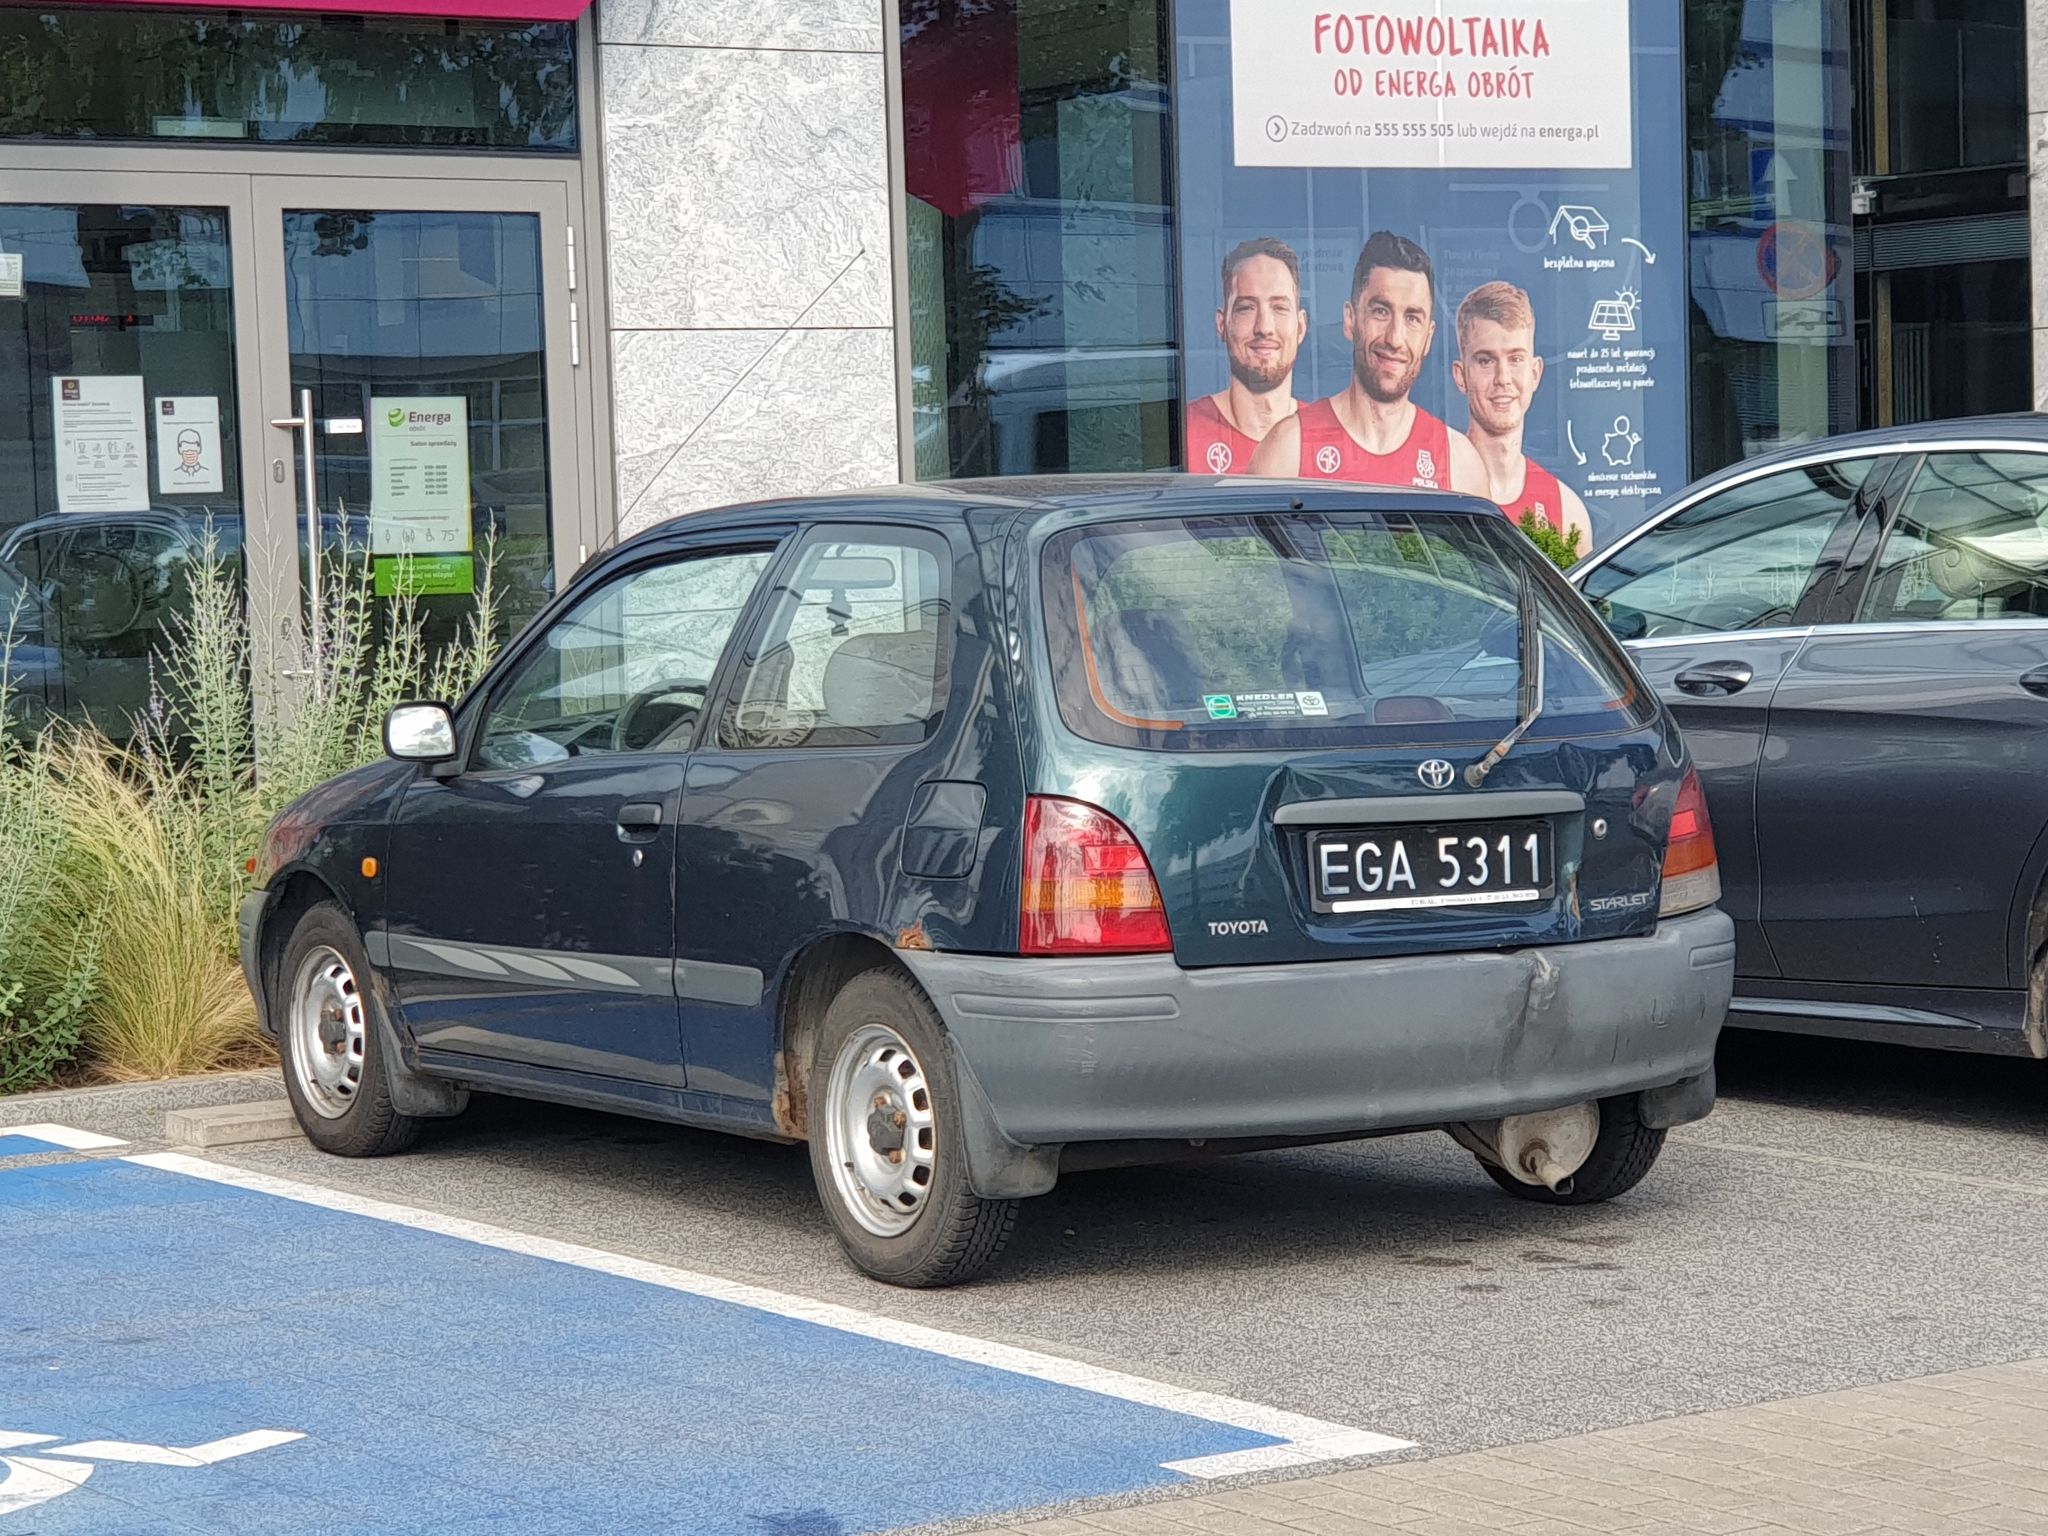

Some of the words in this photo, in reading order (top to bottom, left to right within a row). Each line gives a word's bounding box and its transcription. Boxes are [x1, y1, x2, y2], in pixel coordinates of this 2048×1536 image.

[1314, 13, 1550, 58] FOTOWOLTAIKA
[1334, 68, 1362, 96] OD
[1375, 69, 1456, 98] ENERGA
[1468, 65, 1534, 99] OBRÓT
[1291, 121, 1351, 136] Zadzwoń
[1355, 125, 1371, 136] na
[1375, 123, 1399, 137] 555
[1402, 123, 1427, 137] 555
[1430, 124, 1454, 137] 505
[1457, 123, 1477, 138] lub
[1480, 123, 1517, 141] wejdź
[1521, 126, 1535, 137] na
[1539, 124, 1599, 141] energa.pl
[409, 412, 451, 426] Energa
[1236, 693, 1294, 701] KNEDLER
[1320, 840, 1416, 895] EGA
[1438, 833, 1539, 887] 5311
[1590, 892, 1650, 911] STARLET
[1208, 919, 1269, 936] TOYOTA
